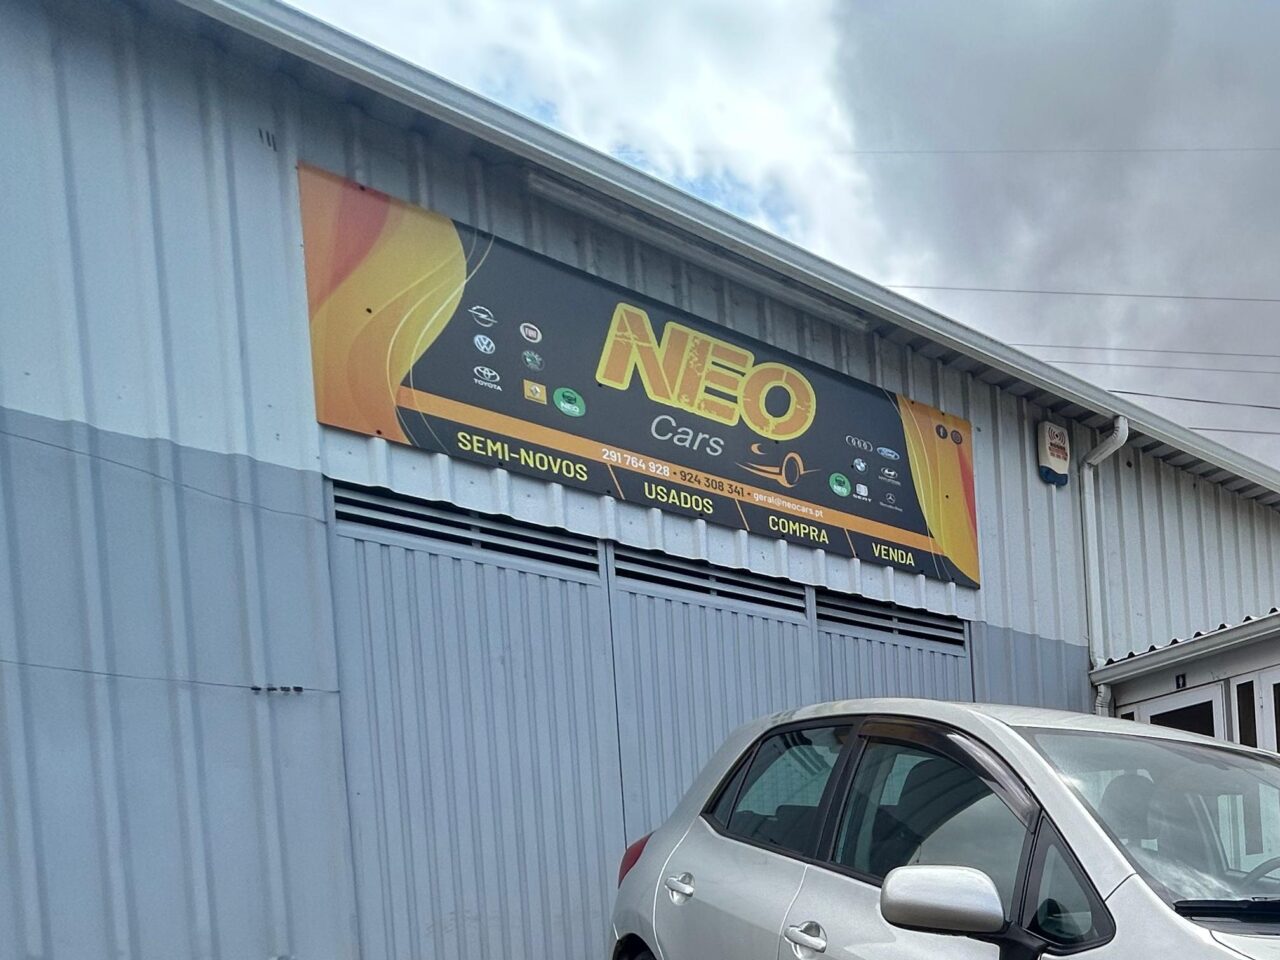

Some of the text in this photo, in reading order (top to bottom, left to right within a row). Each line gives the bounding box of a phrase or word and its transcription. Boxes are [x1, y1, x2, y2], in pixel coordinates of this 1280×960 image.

[473, 377, 503, 392] TOYOTA
[596, 302, 816, 441] NEO
[650, 415, 725, 456] Cars
[457, 431, 588, 481] SEMI-NOVOS
[602, 448, 824, 519] 291 764 928 924 308 341 geral@neocars.pt
[643, 481, 714, 514] USADOS
[768, 515, 829, 545] COMPRA
[872, 541, 916, 567] VENDA
